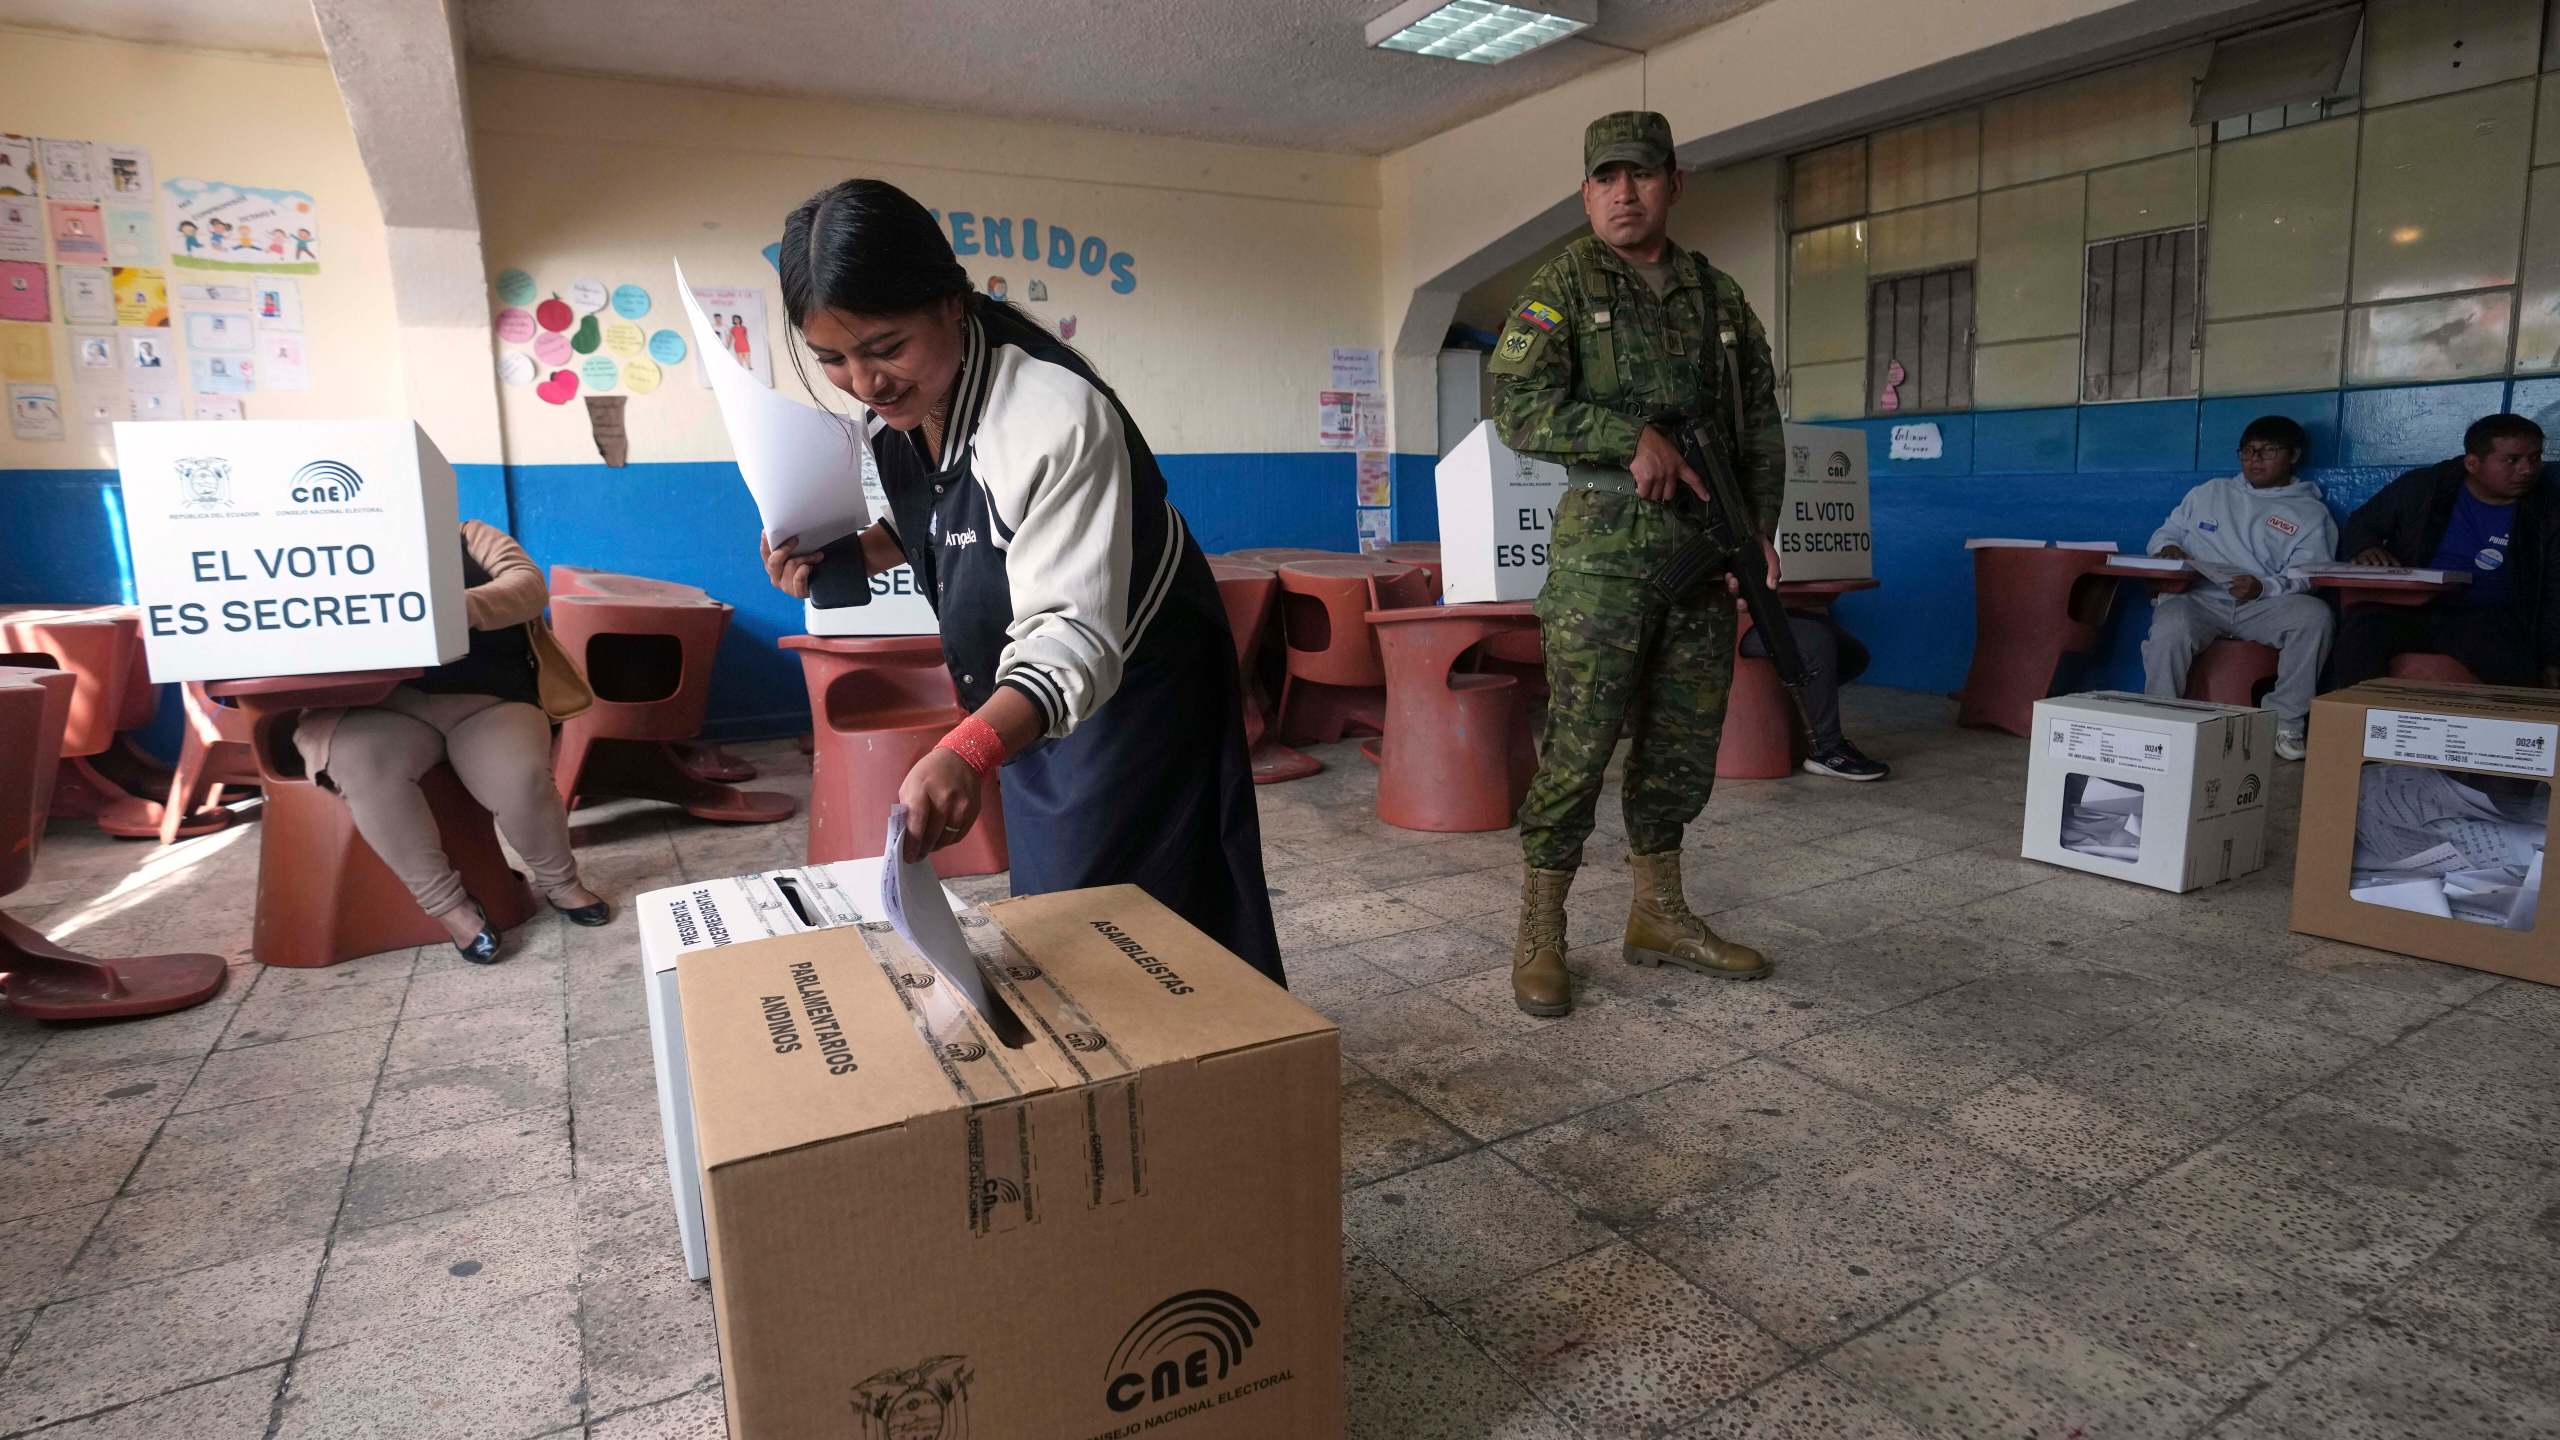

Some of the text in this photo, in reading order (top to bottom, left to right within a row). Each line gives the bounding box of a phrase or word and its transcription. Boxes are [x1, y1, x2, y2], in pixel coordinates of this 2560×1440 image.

[291, 485, 339, 503] CNE
[1518, 508, 1545, 531] EL
[1795, 502, 1854, 522] EL VOTO
[2266, 517, 2295, 534] NASA
[945, 528, 977, 550] Angela
[1781, 532, 1870, 553] ES SECRETO
[191, 543, 375, 582] EL VOTO
[1497, 544, 1526, 567] ES
[148, 591, 427, 636] ES SECRETO
[2515, 737, 2537, 748] 0024
[1089, 921, 1195, 995] ASAMBLEÍSTAS
[760, 995, 803, 1054] ANDINOS
[789, 961, 858, 1076] PARLAMENTARIOS
[945, 1043, 965, 1058] CNE
[1065, 1033, 1086, 1049] CNE
[1106, 1350, 1208, 1413] CNE
[1086, 1369, 1295, 1440] NSEJO NACIONAL ELECTORAL
